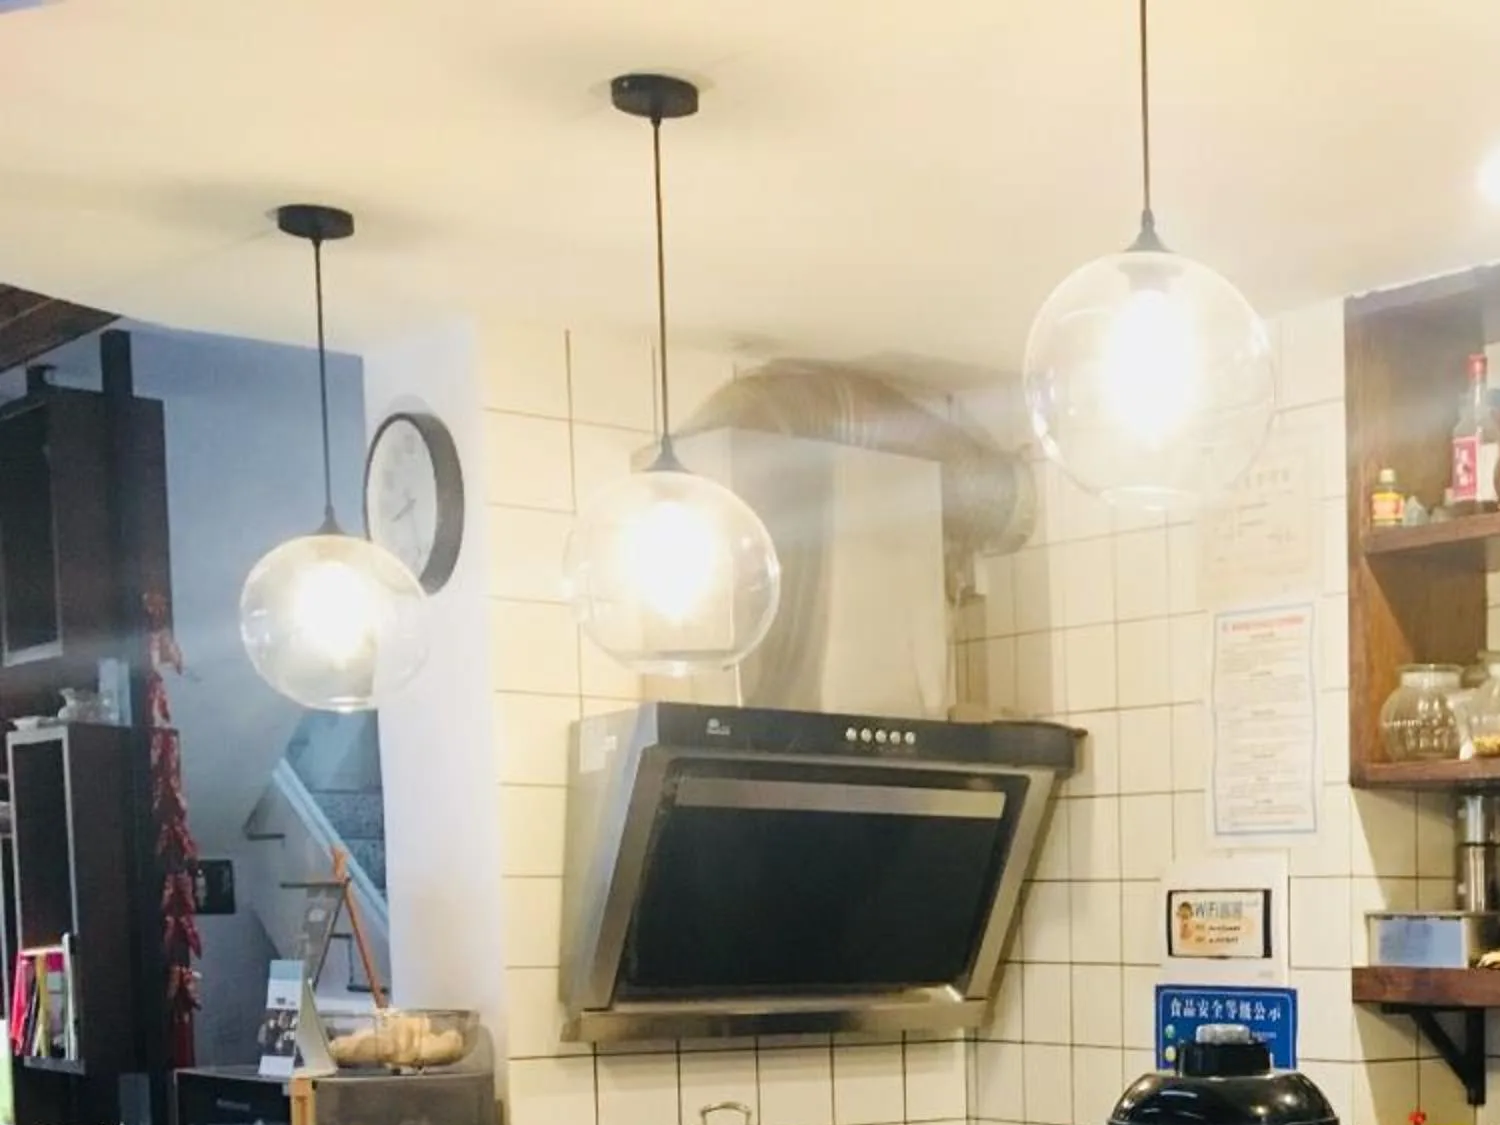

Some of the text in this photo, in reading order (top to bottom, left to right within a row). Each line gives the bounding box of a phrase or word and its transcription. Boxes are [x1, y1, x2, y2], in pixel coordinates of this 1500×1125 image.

[1170, 996, 1281, 1022] 食品安全等级公示
